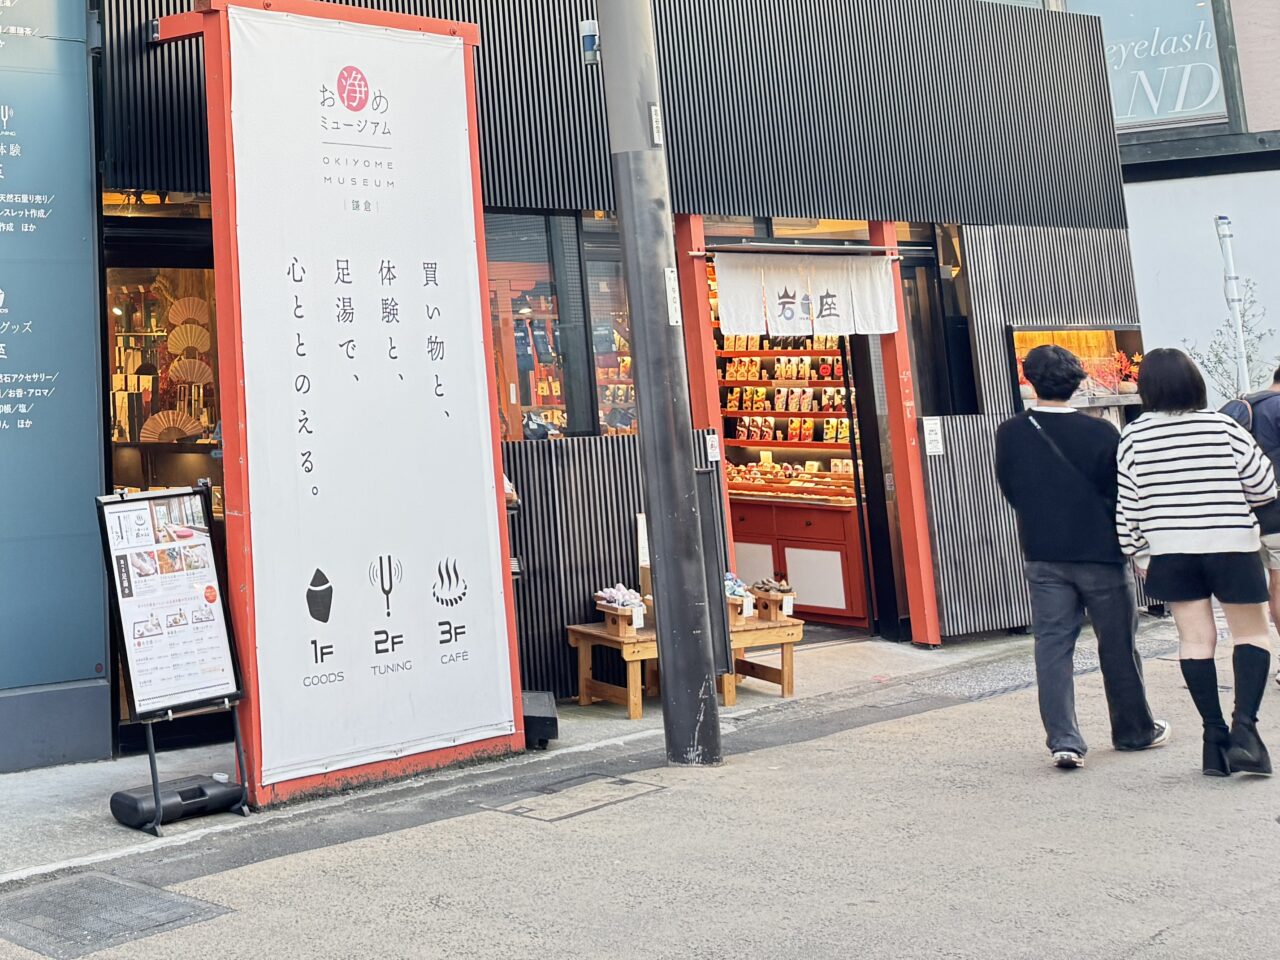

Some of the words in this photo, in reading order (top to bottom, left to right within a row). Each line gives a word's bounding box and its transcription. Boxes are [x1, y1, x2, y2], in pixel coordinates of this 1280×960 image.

[1106, 19, 1215, 71] eyelash
[319, 70, 390, 114] お浄め
[320, 115, 392, 136] ミュージアム
[322, 156, 394, 170] OKIYOME
[323, 176, 395, 188] MUSEUM
[351, 199, 372, 212] 鎌倉
[334, 259, 360, 382] 足湯で、
[378, 259, 404, 381] 体験と、
[422, 261, 450, 418] 買い物と、
[286, 256, 319, 496] 心ととのえる。
[374, 629, 404, 654] 2F
[438, 620, 467, 645] 3F
[310, 639, 334, 664] 1F
[302, 671, 345, 687] GOODS
[370, 660, 413, 676] TUNING
